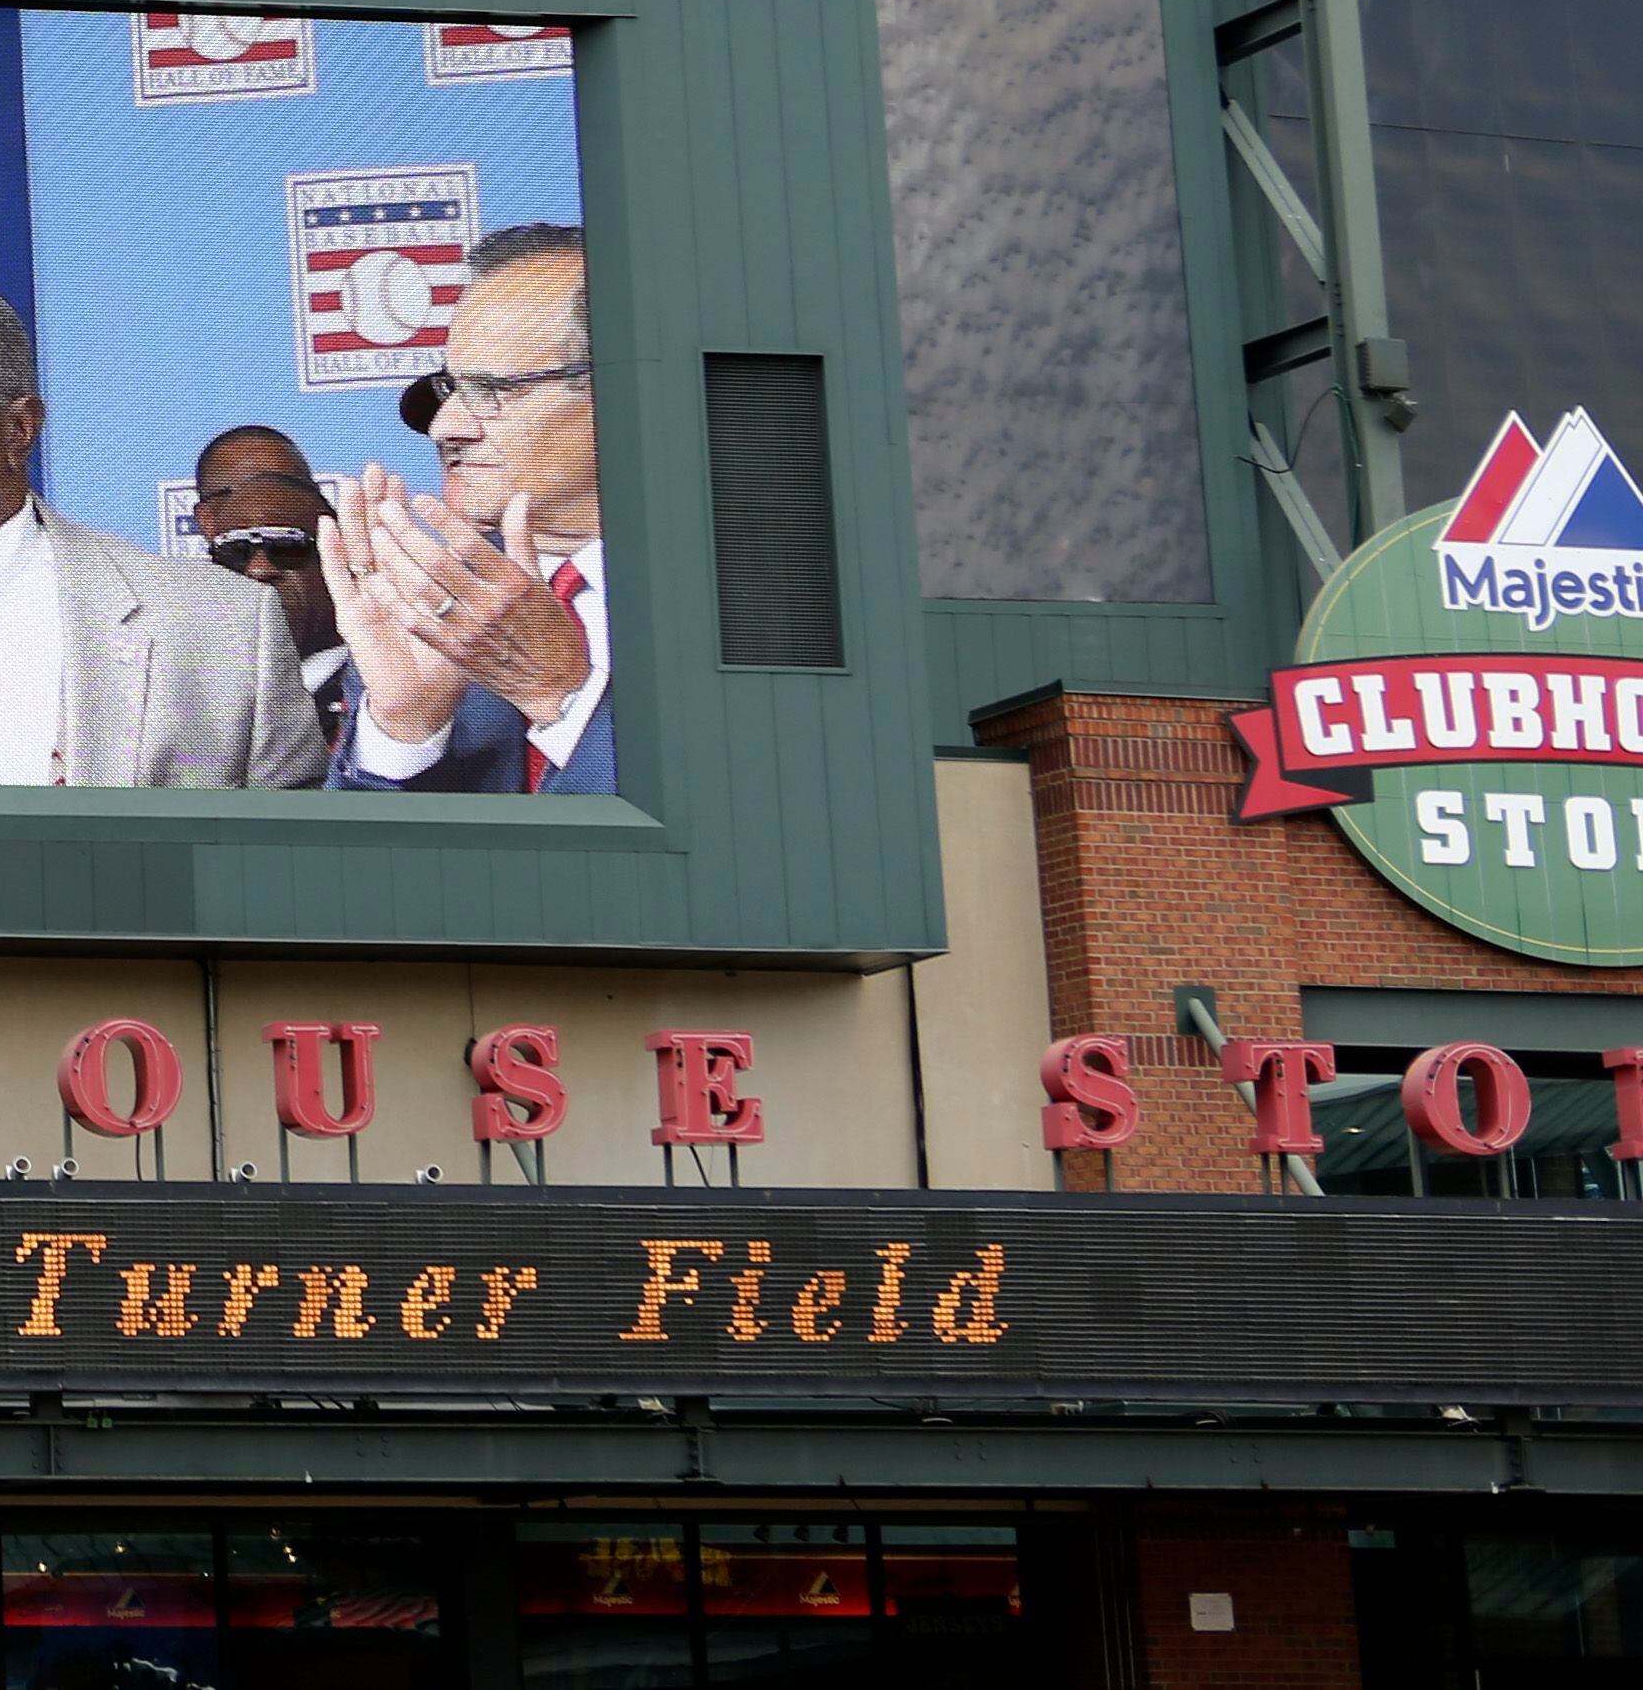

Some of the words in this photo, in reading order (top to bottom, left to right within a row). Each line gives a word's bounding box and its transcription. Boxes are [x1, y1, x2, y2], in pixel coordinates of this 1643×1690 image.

[1417, 790, 1643, 872] STO
[14, 1229, 539, 1342] Turner
[619, 1238, 1010, 1345] Field
